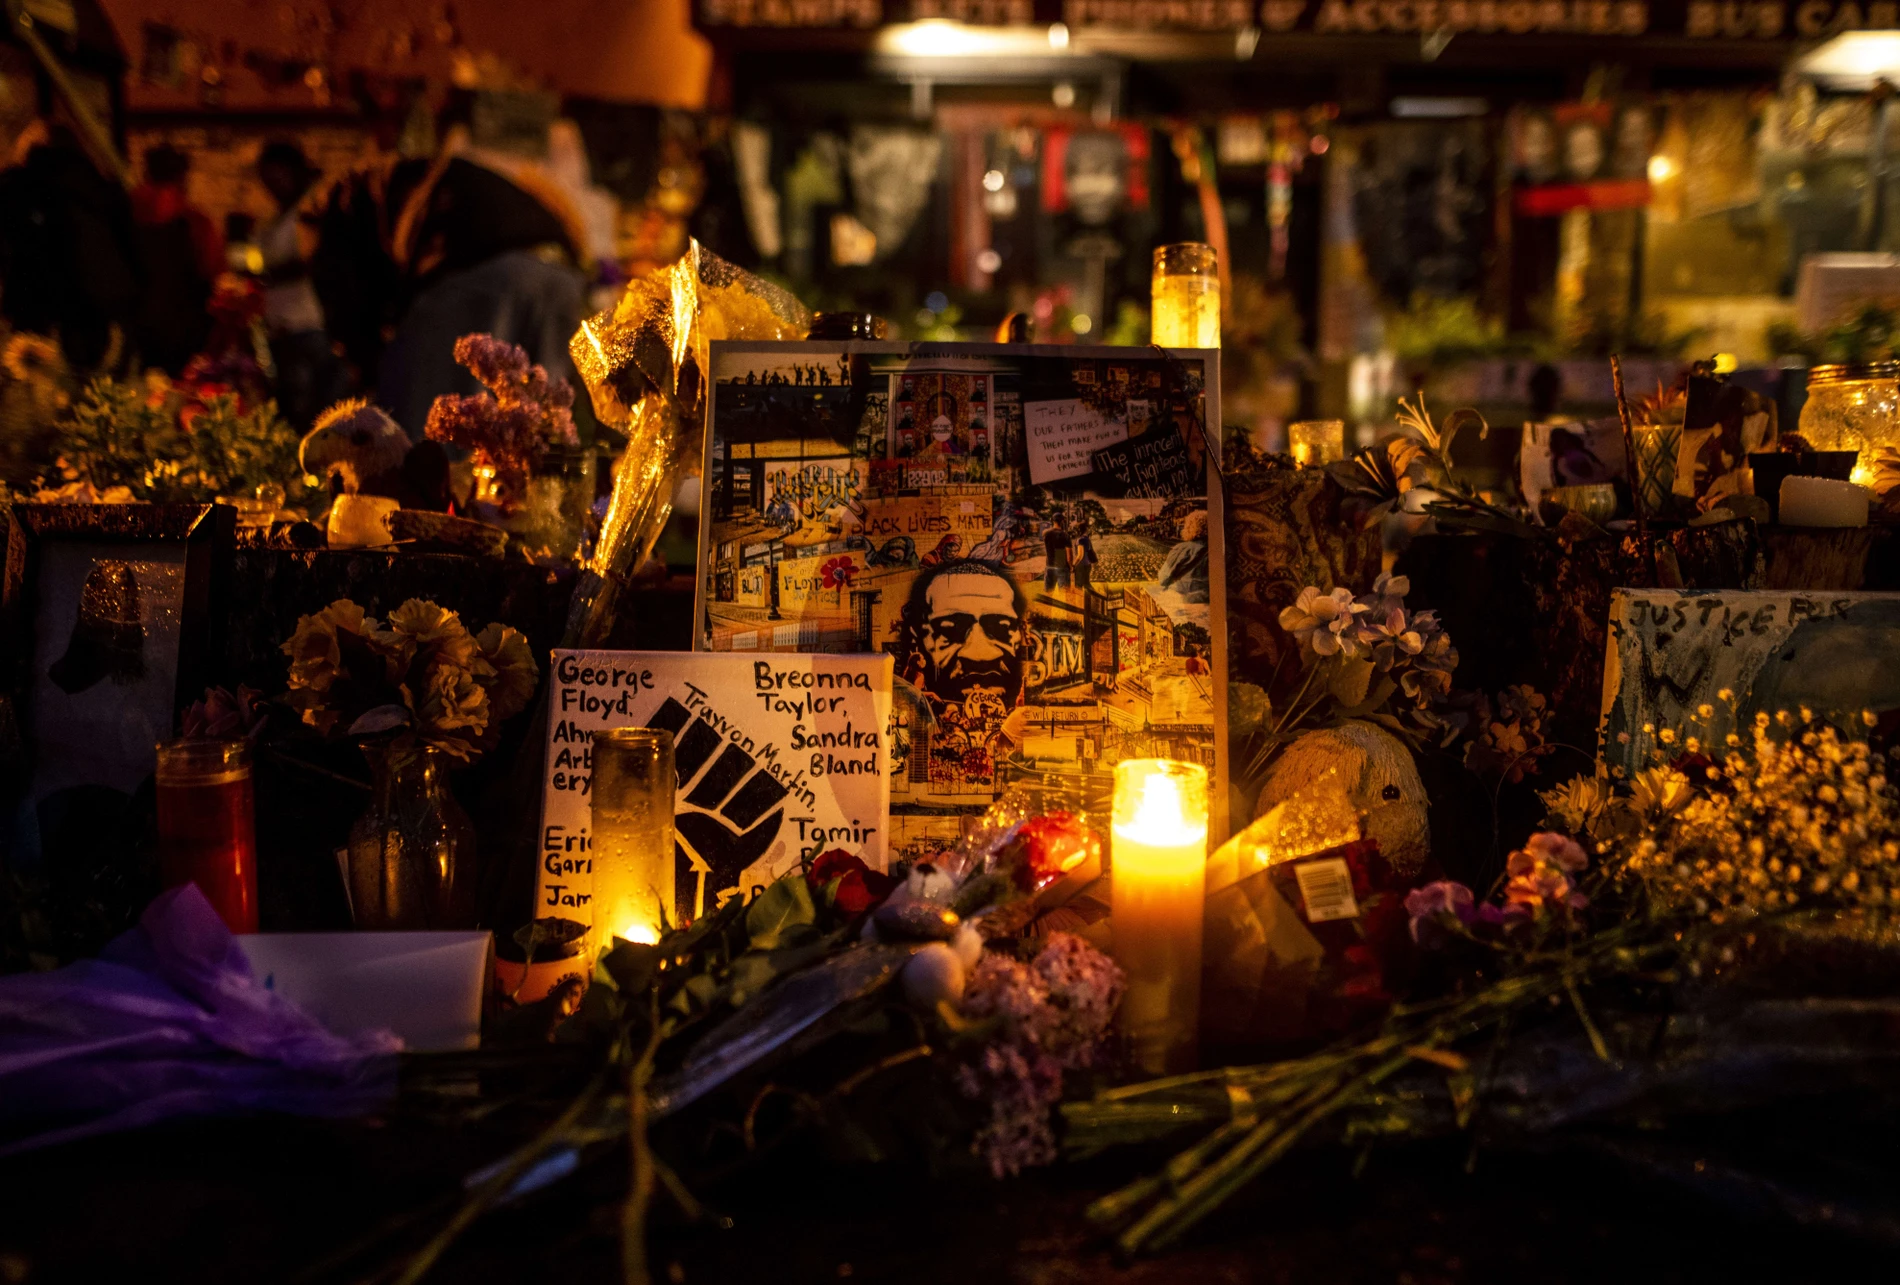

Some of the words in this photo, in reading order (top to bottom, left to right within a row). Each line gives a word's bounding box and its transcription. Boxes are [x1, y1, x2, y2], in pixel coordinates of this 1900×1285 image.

[1314, 0, 1650, 37] ACCESSORIES
[1684, 2, 1785, 39] BUS
[1035, 405, 1076, 418] THEY
[1034, 425, 1054, 437] OUR
[1060, 420, 1099, 432] FATHERS
[1040, 440, 1064, 450] THEN
[1068, 436, 1091, 445] MAKE
[1097, 450, 1129, 472] The
[1132, 428, 1183, 460] innocent
[908, 513, 952, 532] LIVES
[1629, 599, 1777, 640] JUSTICE
[558, 655, 655, 699] George
[754, 661, 873, 692] Breonna
[684, 682, 755, 753] Trayvon
[757, 692, 847, 721] Taylor,
[790, 721, 880, 751] Sandra
[809, 752, 881, 778] Bland,
[788, 816, 878, 845] Tamir
